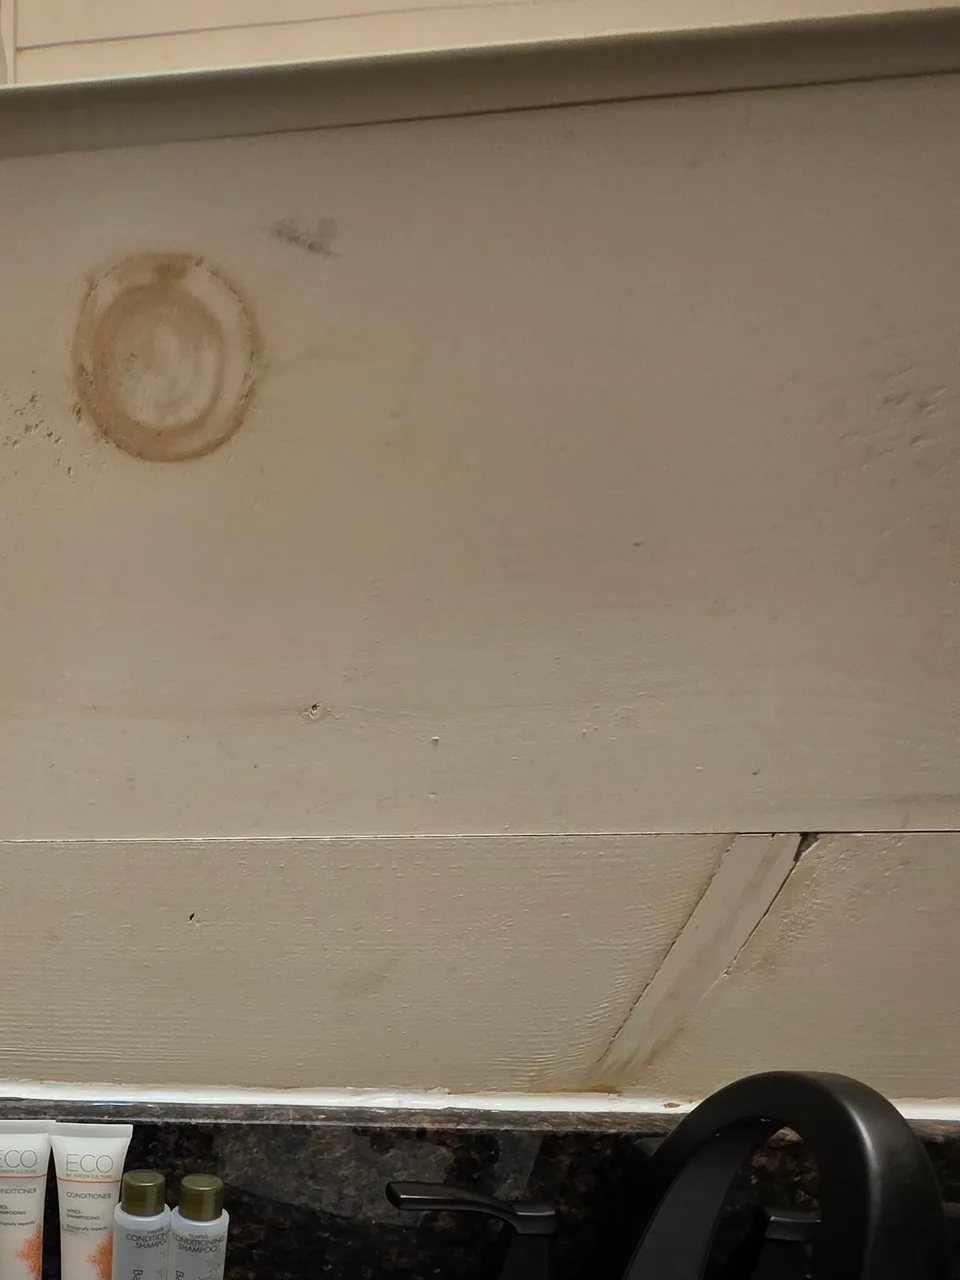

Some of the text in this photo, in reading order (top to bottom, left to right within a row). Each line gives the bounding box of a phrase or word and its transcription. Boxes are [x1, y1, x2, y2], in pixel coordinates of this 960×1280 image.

[66, 1153, 114, 1174] ECO
[66, 1191, 113, 1200] CONDITIONER
[172, 1232, 225, 1247] CONDITIONING
[178, 1242, 218, 1254] SHAMPOO
